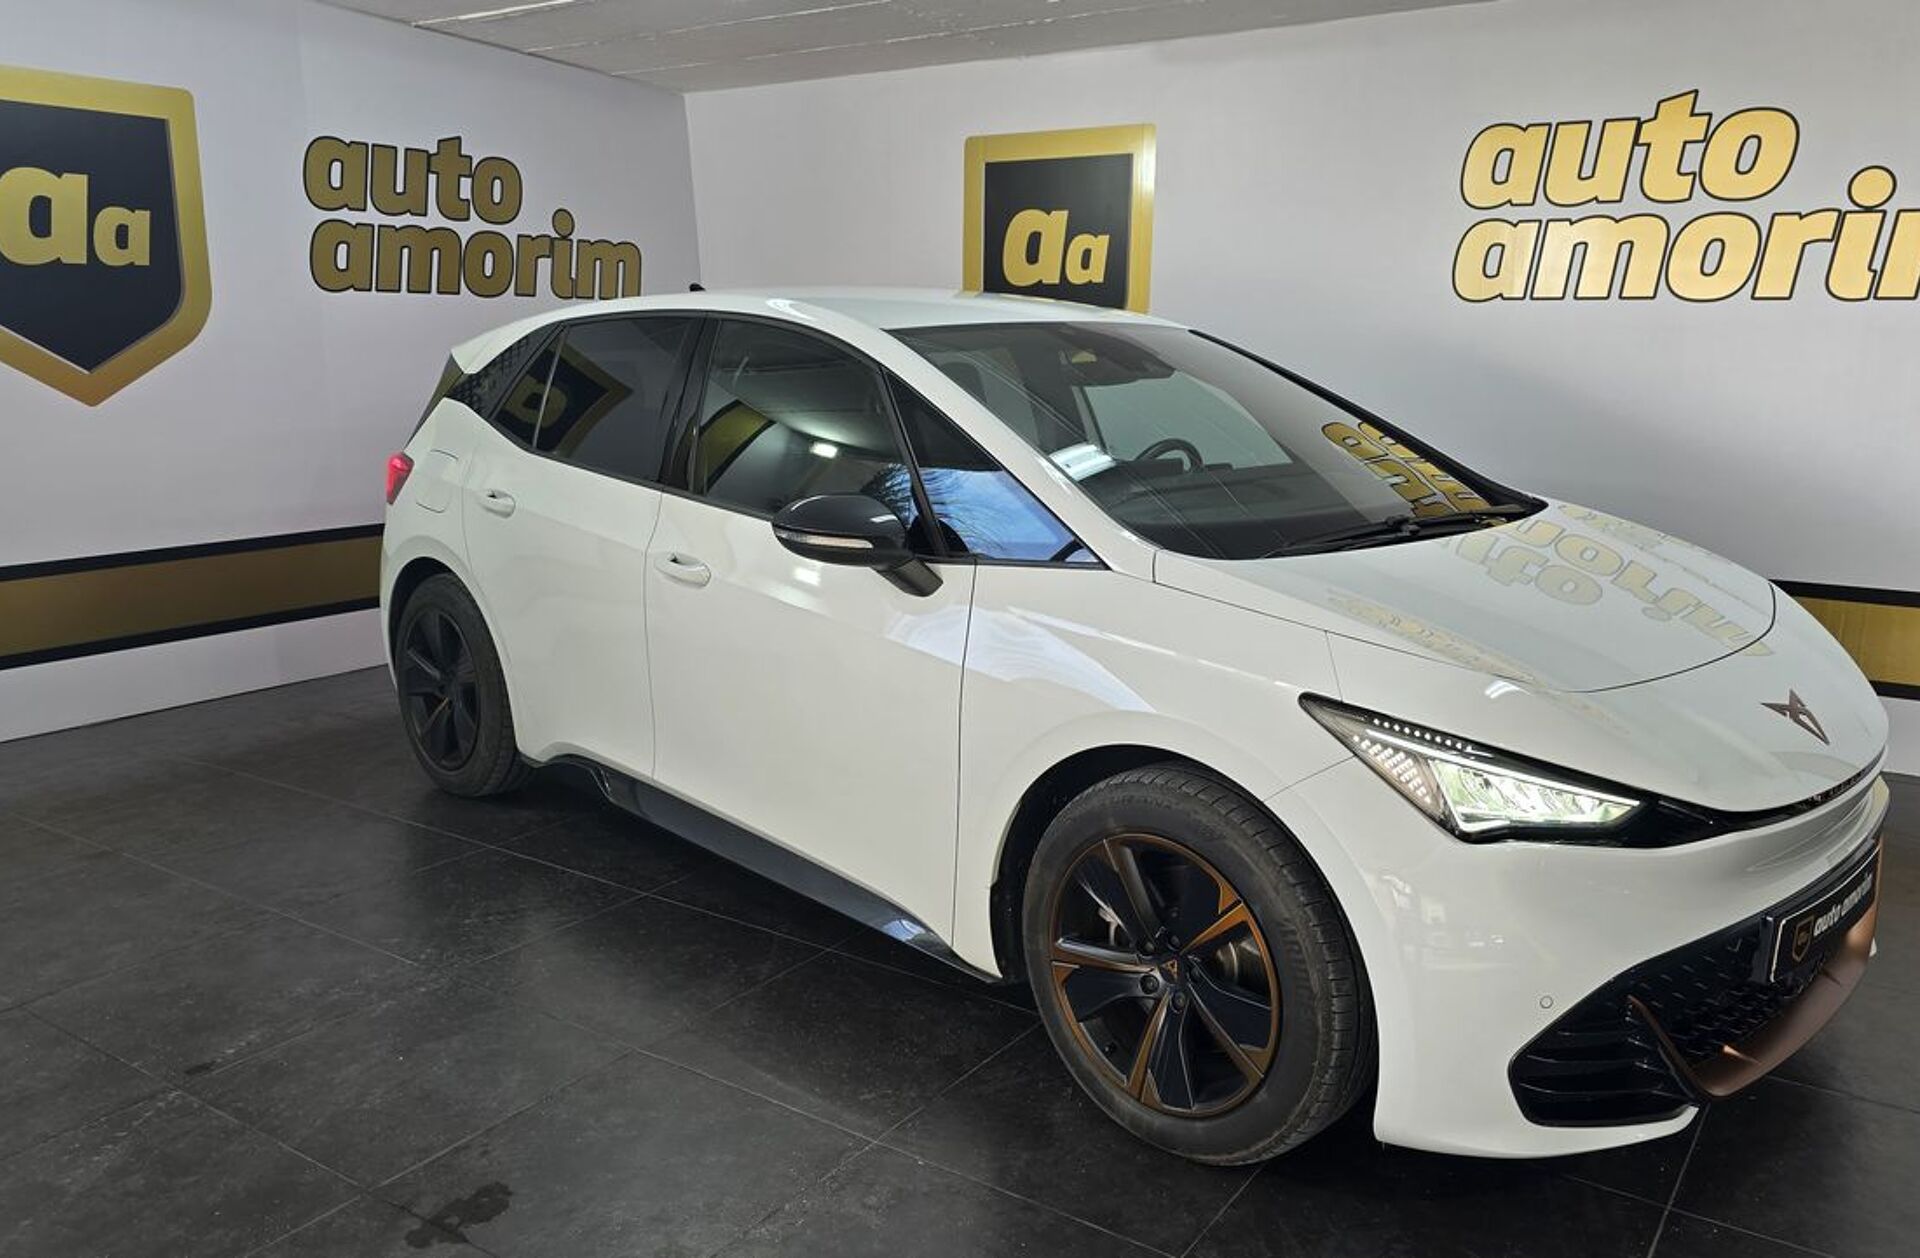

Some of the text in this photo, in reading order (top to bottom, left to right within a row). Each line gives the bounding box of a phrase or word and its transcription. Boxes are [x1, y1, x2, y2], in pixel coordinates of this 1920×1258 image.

[303, 135, 523, 225] auto
[1460, 89, 1800, 210] auto
[310, 208, 642, 300] amorim
